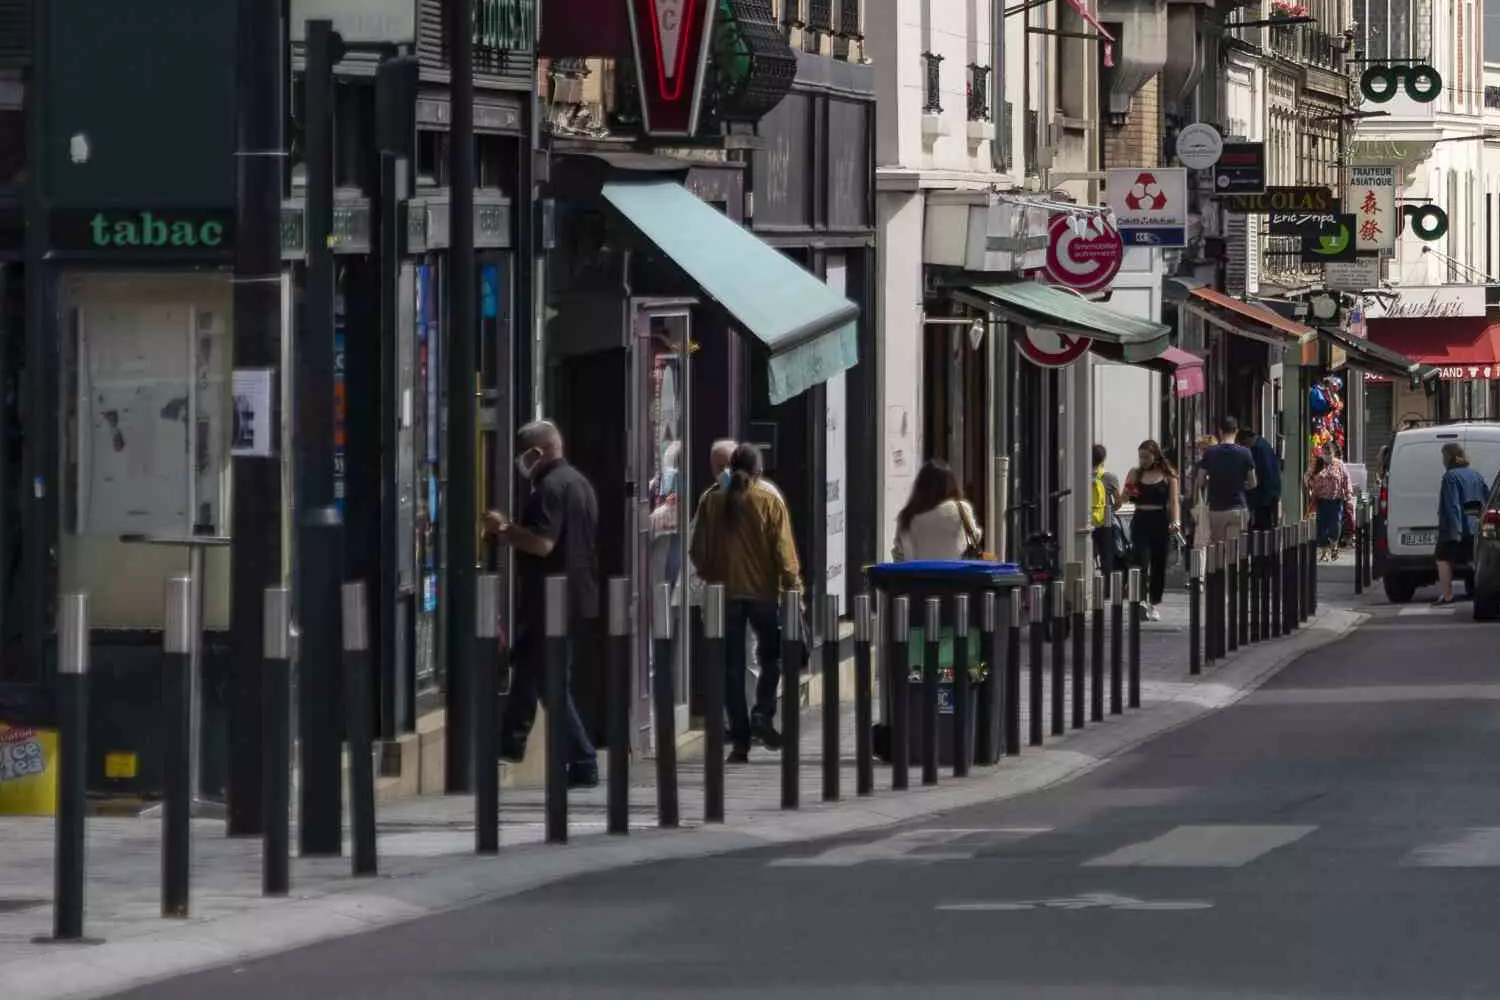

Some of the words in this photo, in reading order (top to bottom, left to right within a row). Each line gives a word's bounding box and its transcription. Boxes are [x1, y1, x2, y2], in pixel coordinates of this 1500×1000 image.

[1352, 167, 1392, 176] TRAITEUR
[1350, 177, 1393, 186] ASIATIQUE
[1232, 191, 1327, 210] NICOLAS
[90, 211, 223, 246] tabac
